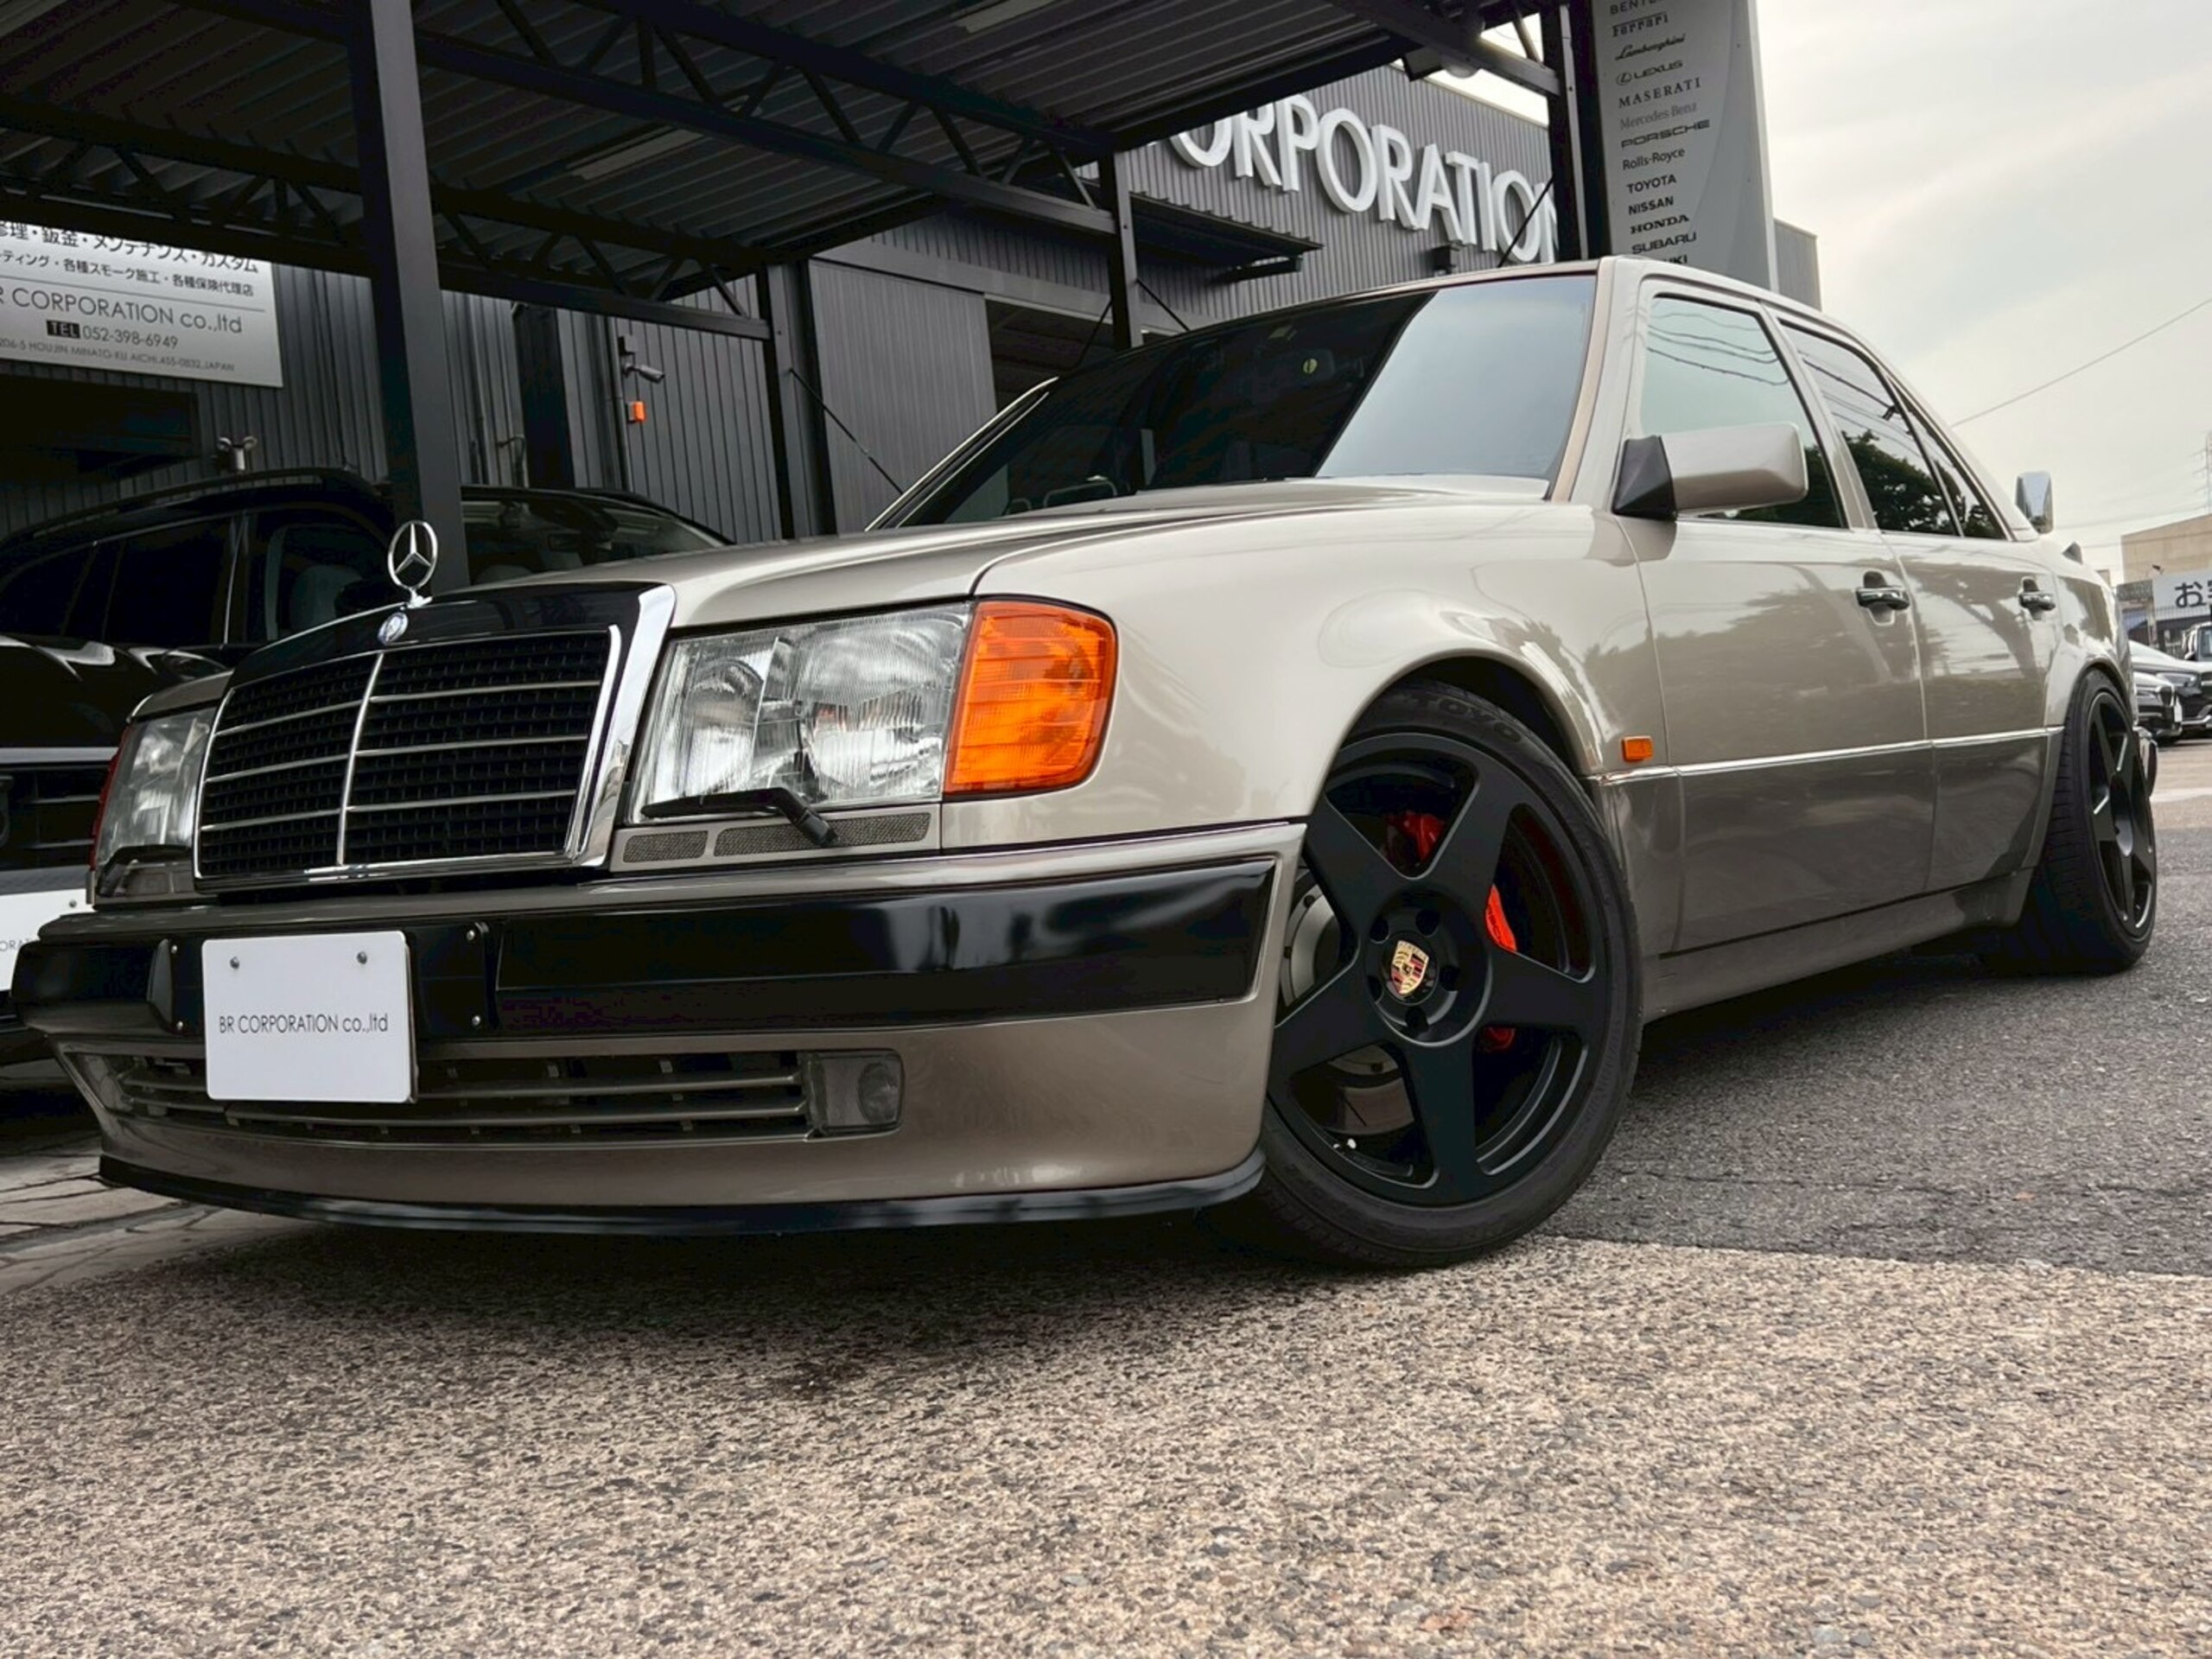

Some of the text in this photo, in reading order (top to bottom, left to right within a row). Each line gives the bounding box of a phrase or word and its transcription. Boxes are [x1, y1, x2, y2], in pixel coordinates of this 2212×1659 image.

[1612, 11, 1669, 37] Ferrari
[1633, 60, 1683, 79] LEXUS
[1618, 77, 1701, 109] MASERATI
[1621, 118, 1710, 149] PORSCHE
[1622, 148, 1686, 170] Rolls-Royce
[1626, 174, 1677, 194] TOYOTA
[1628, 195, 1675, 215] NISSAN
[1630, 213, 1689, 235] HONDA
[1631, 232, 1697, 255] SUBARU
[12, 287, 175, 325] CORPORATION
[49, 320, 178, 349] TEL 052-398-6949
[2175, 581, 2212, 607] お
[219, 1015, 234, 1033] BR
[238, 1014, 338, 1033] CORPORATION
